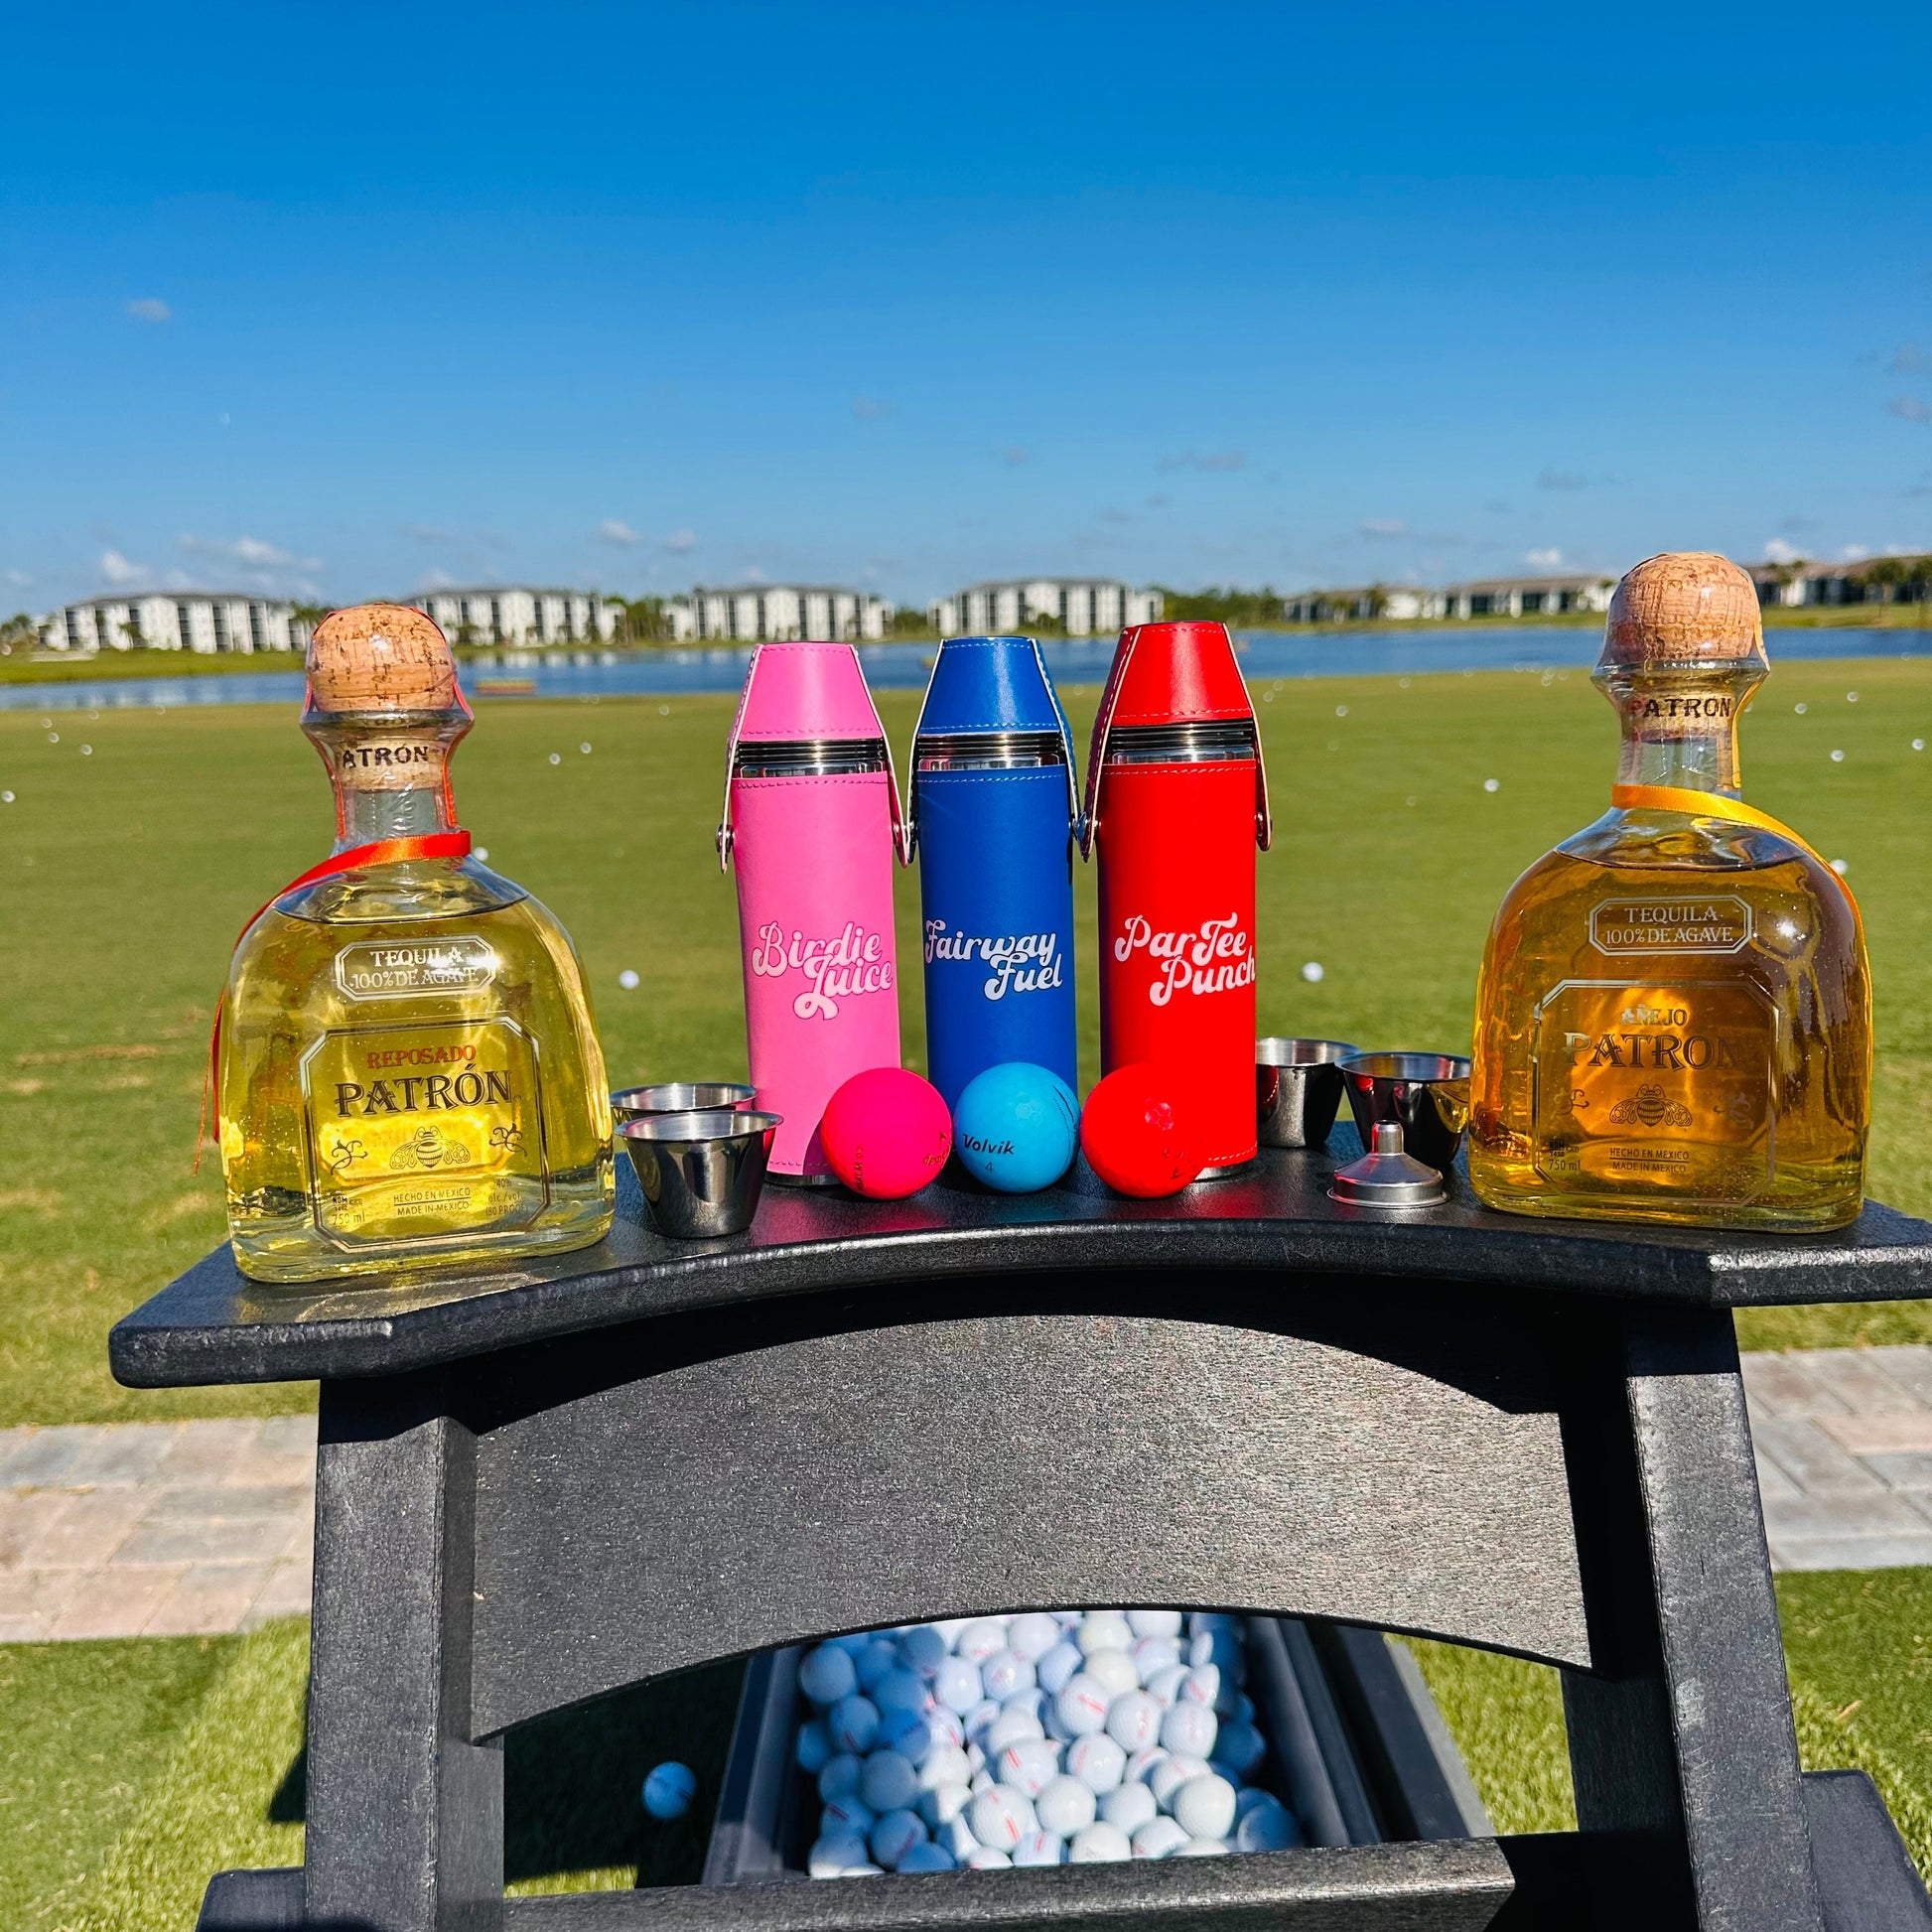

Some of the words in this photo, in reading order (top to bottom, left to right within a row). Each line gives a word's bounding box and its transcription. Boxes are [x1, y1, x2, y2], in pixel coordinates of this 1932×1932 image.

[1624, 905, 1719, 923] TEQUILA
[924, 919, 1055, 966] Fairway
[1114, 911, 1247, 966] ParTee
[1605, 928, 1645, 944] 100%
[1647, 928, 1671, 943] DE
[1673, 926, 1733, 943] AGAVE
[369, 946, 465, 968] TEQUILA
[752, 920, 882, 978] Birdie
[352, 971, 393, 990] 100%
[396, 969, 419, 987] DE
[984, 951, 1063, 1001] Fuel
[1149, 945, 1256, 1006] Punch
[792, 954, 894, 1021] Juice
[1620, 1003, 1688, 1027] AÑEJO
[366, 1044, 477, 1069] REPOSADO
[334, 1063, 513, 1118] PATRÓN
[962, 1134, 1015, 1156] Volvik
[1609, 1148, 1639, 1159] HECHO
[1641, 1149, 1653, 1159] EN
[1655, 1149, 1690, 1160] MEXICO
[985, 1162, 994, 1173] 4
[1548, 1159, 1566, 1171] 750
[1569, 1160, 1581, 1171] ml
[1612, 1162, 1638, 1172] MADE
[1640, 1162, 1650, 1172] IN
[1652, 1162, 1687, 1173] MEXICO
[393, 1193, 423, 1203] HECHO
[425, 1190, 437, 1200] EN
[438, 1187, 471, 1198] MEXICO
[331, 1212, 350, 1226] 750
[397, 1204, 423, 1216] MADE
[424, 1203, 434, 1213] IN
[436, 1201, 470, 1212] MEXICO
